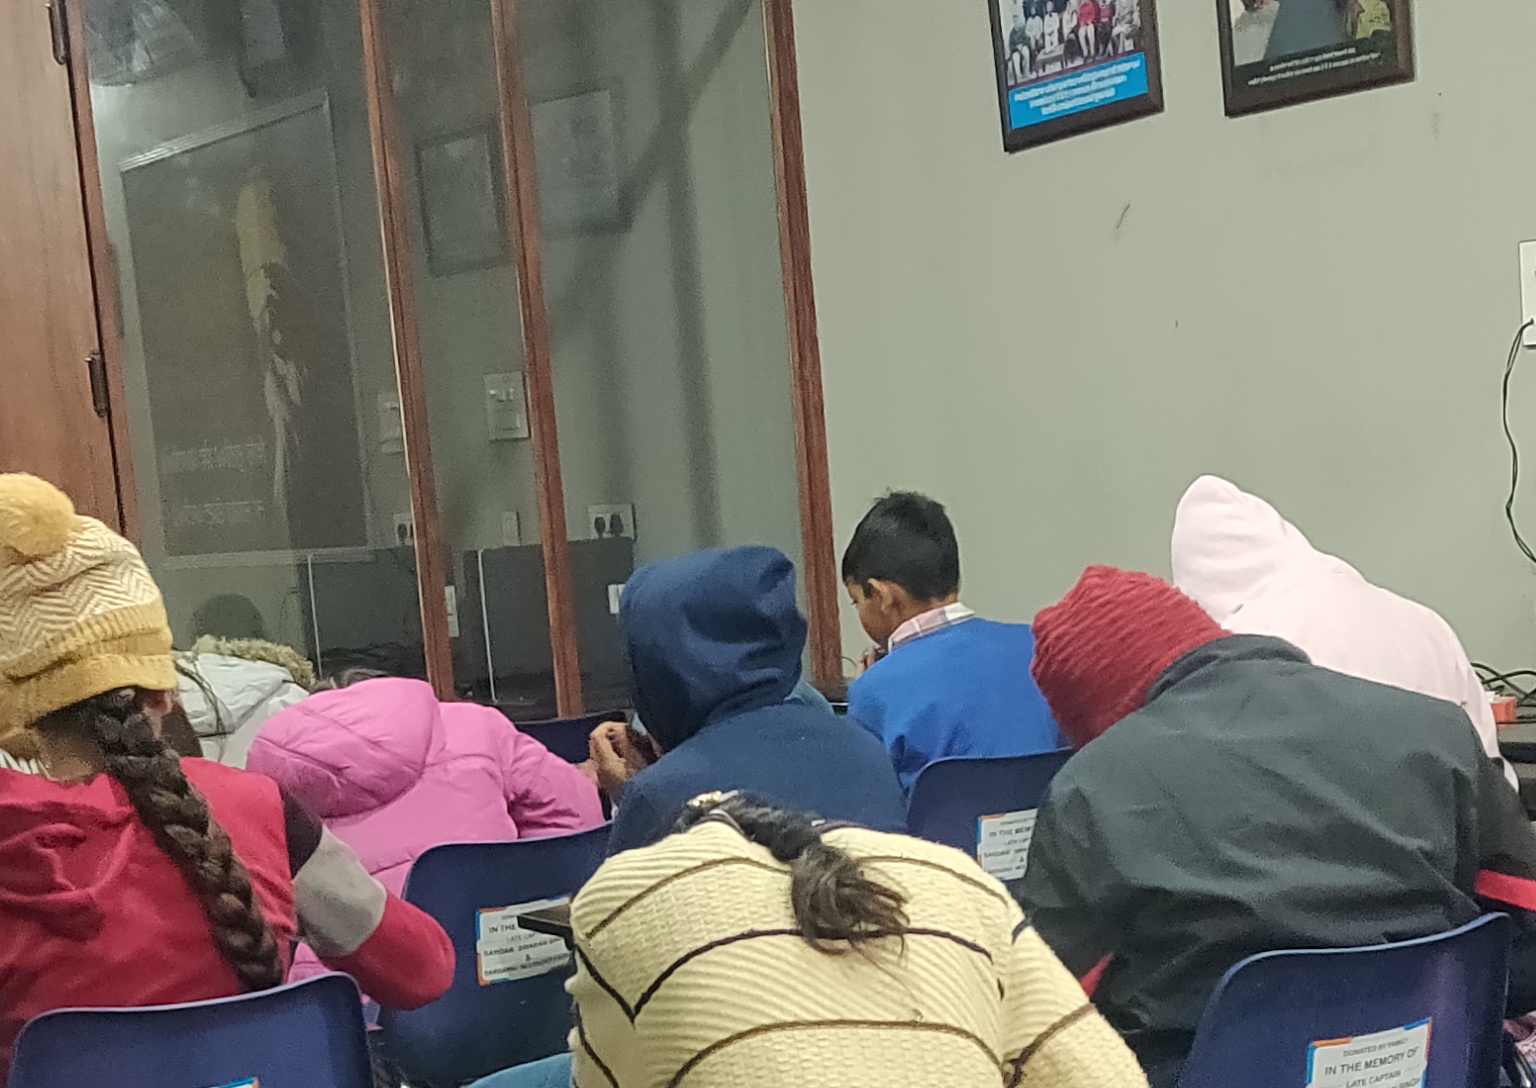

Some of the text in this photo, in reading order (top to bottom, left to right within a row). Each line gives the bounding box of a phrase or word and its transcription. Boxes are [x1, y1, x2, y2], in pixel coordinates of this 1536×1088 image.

[1325, 1047, 1419, 1075] IN THE MEMORY OF
[1346, 1070, 1401, 1088] LATE CAPTAIN
